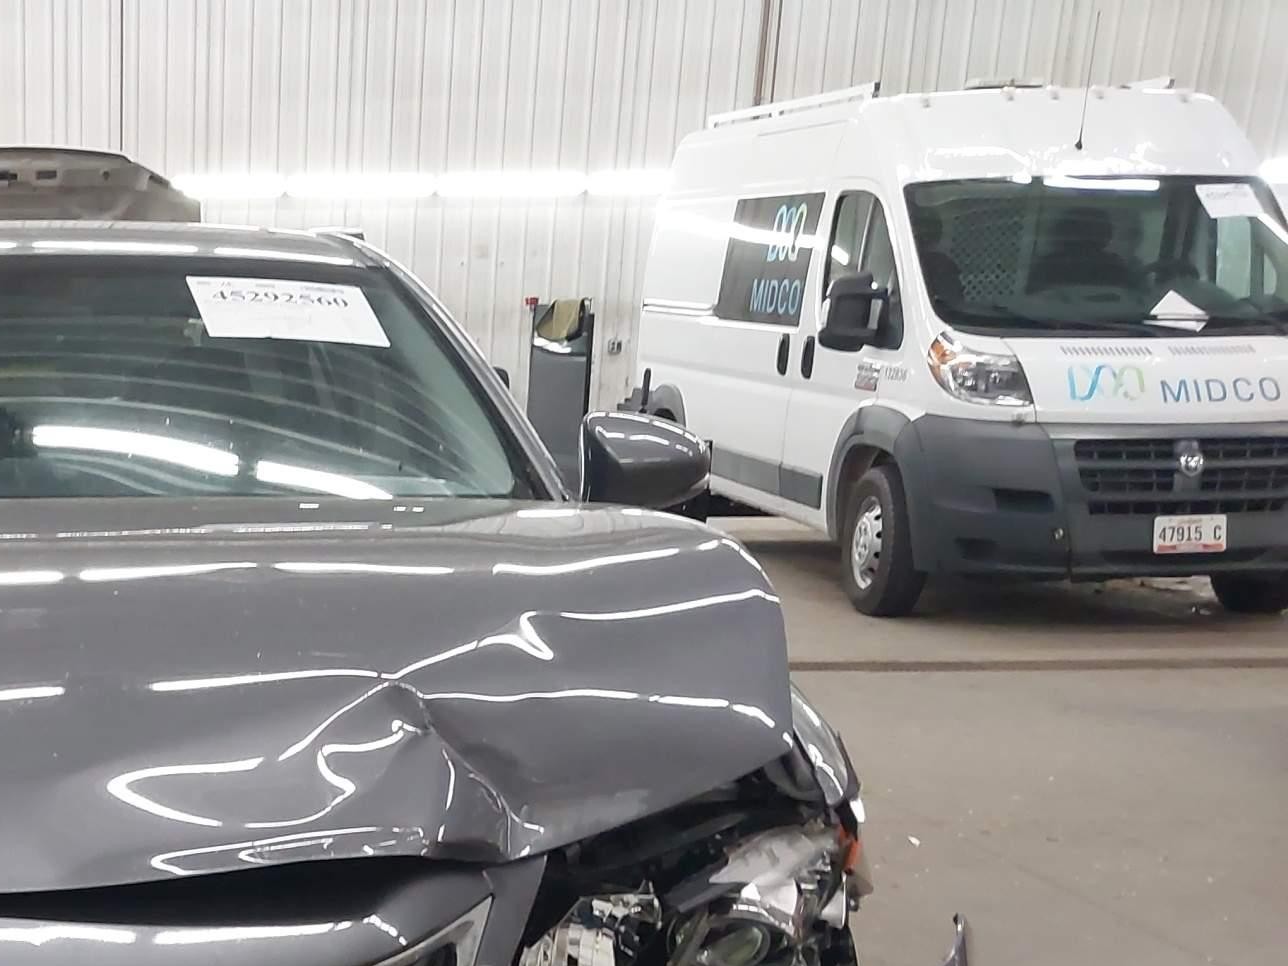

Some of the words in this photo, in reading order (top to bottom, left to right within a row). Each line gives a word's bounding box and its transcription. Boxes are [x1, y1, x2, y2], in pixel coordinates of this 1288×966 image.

[212, 290, 348, 308] 45292560
[750, 279, 801, 314] MIDCO
[1161, 376, 1281, 403] MIDCO
[1159, 526, 1202, 542] 47915
[1213, 525, 1222, 541] C
